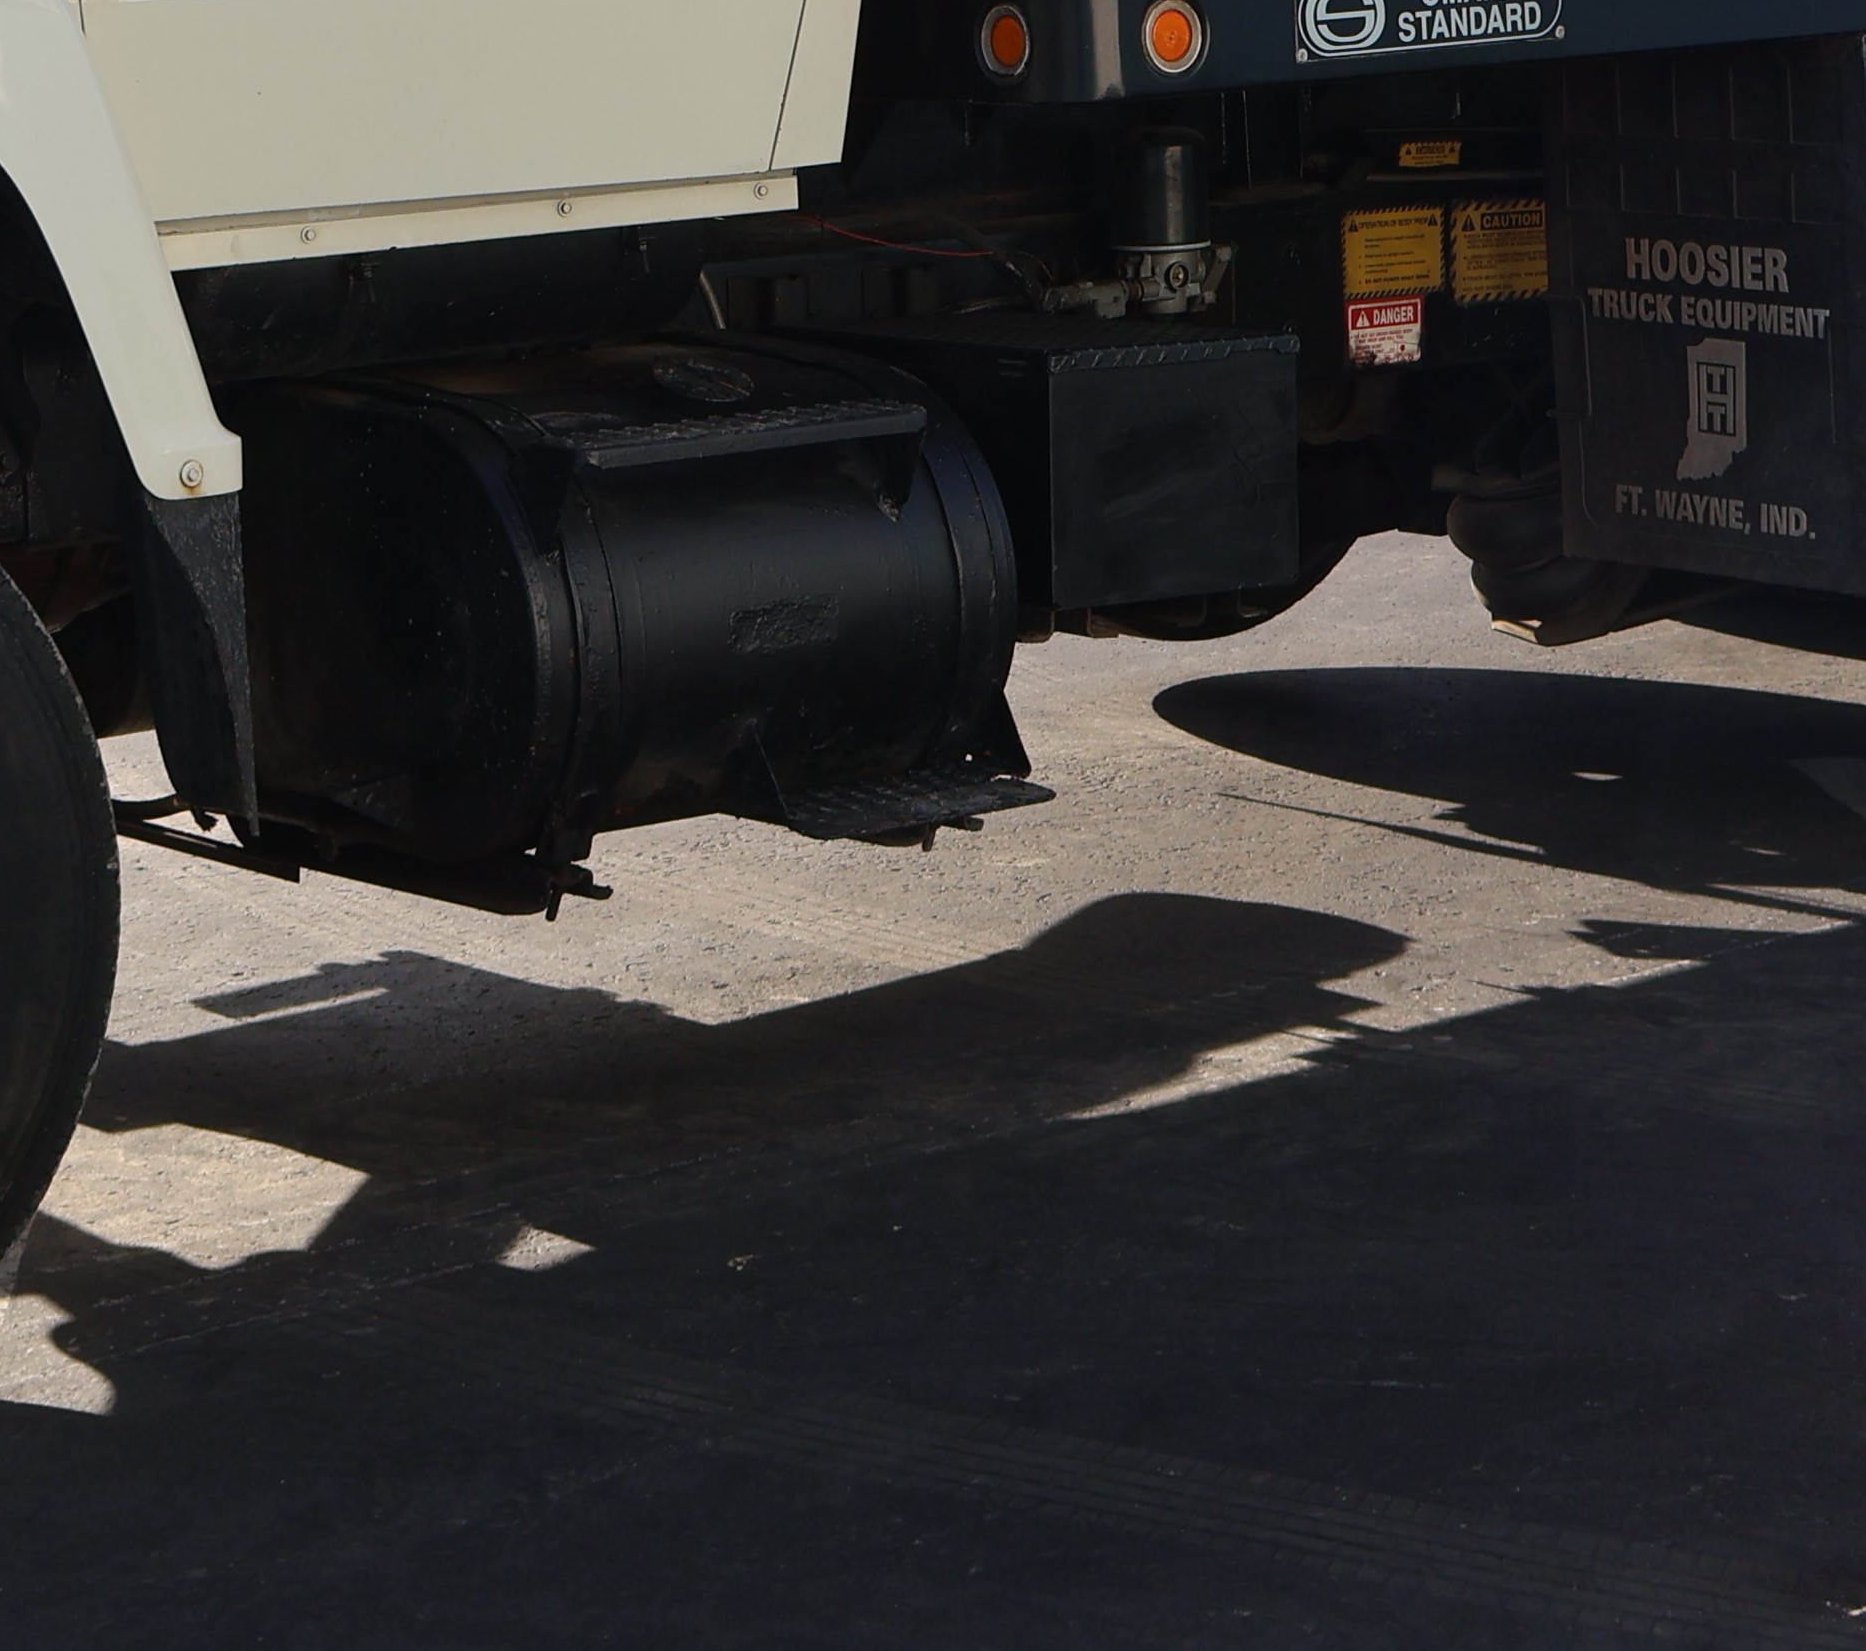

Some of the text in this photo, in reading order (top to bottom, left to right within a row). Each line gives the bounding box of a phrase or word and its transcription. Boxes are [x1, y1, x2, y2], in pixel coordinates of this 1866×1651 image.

[1398, 1, 1541, 42] STANDARD
[1483, 211, 1541, 228] CAUTION
[1625, 237, 1789, 293] HOOSIER
[1372, 305, 1414, 325] DANGER
[1588, 288, 1830, 339] TRUCK EQUIPMENT
[1615, 484, 1816, 540] FT. WAYNE, IND.
